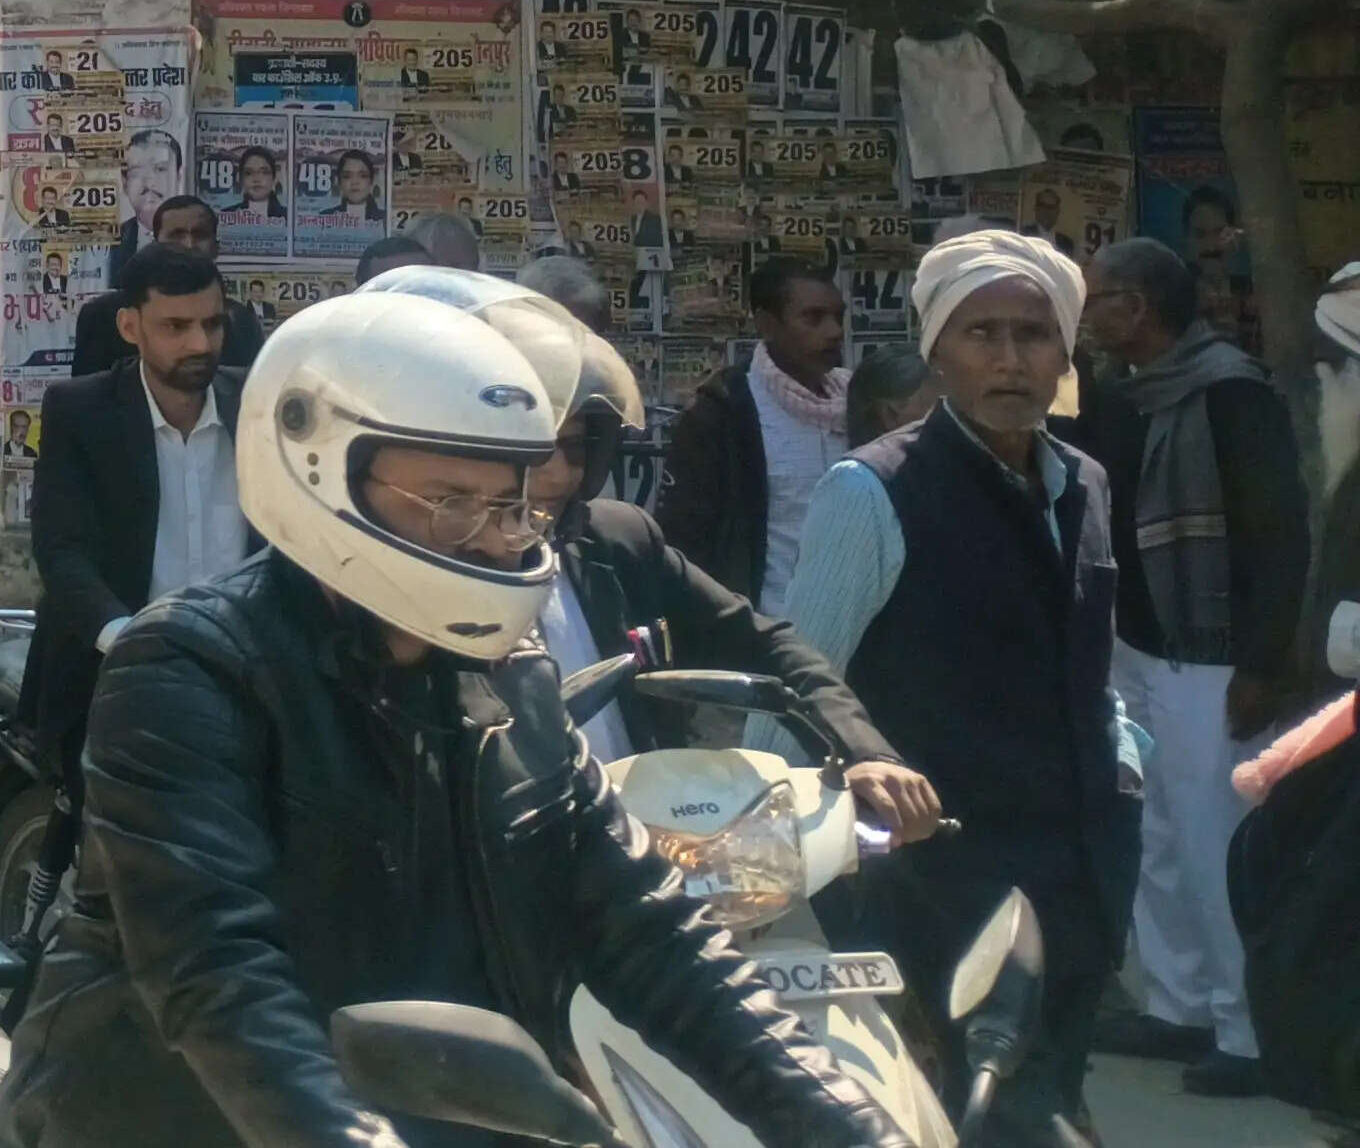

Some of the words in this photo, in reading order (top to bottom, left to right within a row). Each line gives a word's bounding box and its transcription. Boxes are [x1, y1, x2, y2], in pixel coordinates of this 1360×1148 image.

[568, 21, 609, 40] 205
[654, 12, 695, 32] 205
[433, 48, 473, 68] 205
[788, 17, 840, 91] 42
[578, 83, 617, 103] 205
[704, 75, 744, 94] 205
[77, 112, 122, 134] 205
[697, 148, 737, 167] 205
[778, 143, 816, 162] 205
[849, 142, 888, 160] 205
[581, 152, 622, 172] 205
[201, 160, 234, 190] 48
[298, 162, 331, 192] 48
[72, 187, 117, 207] 205
[486, 199, 527, 217] 205
[594, 225, 631, 244] 205
[784, 218, 824, 238] 205
[870, 219, 909, 238] 205
[279, 281, 321, 301] 205
[672, 801, 720, 819] Hero
[767, 960, 888, 993] OCATE
